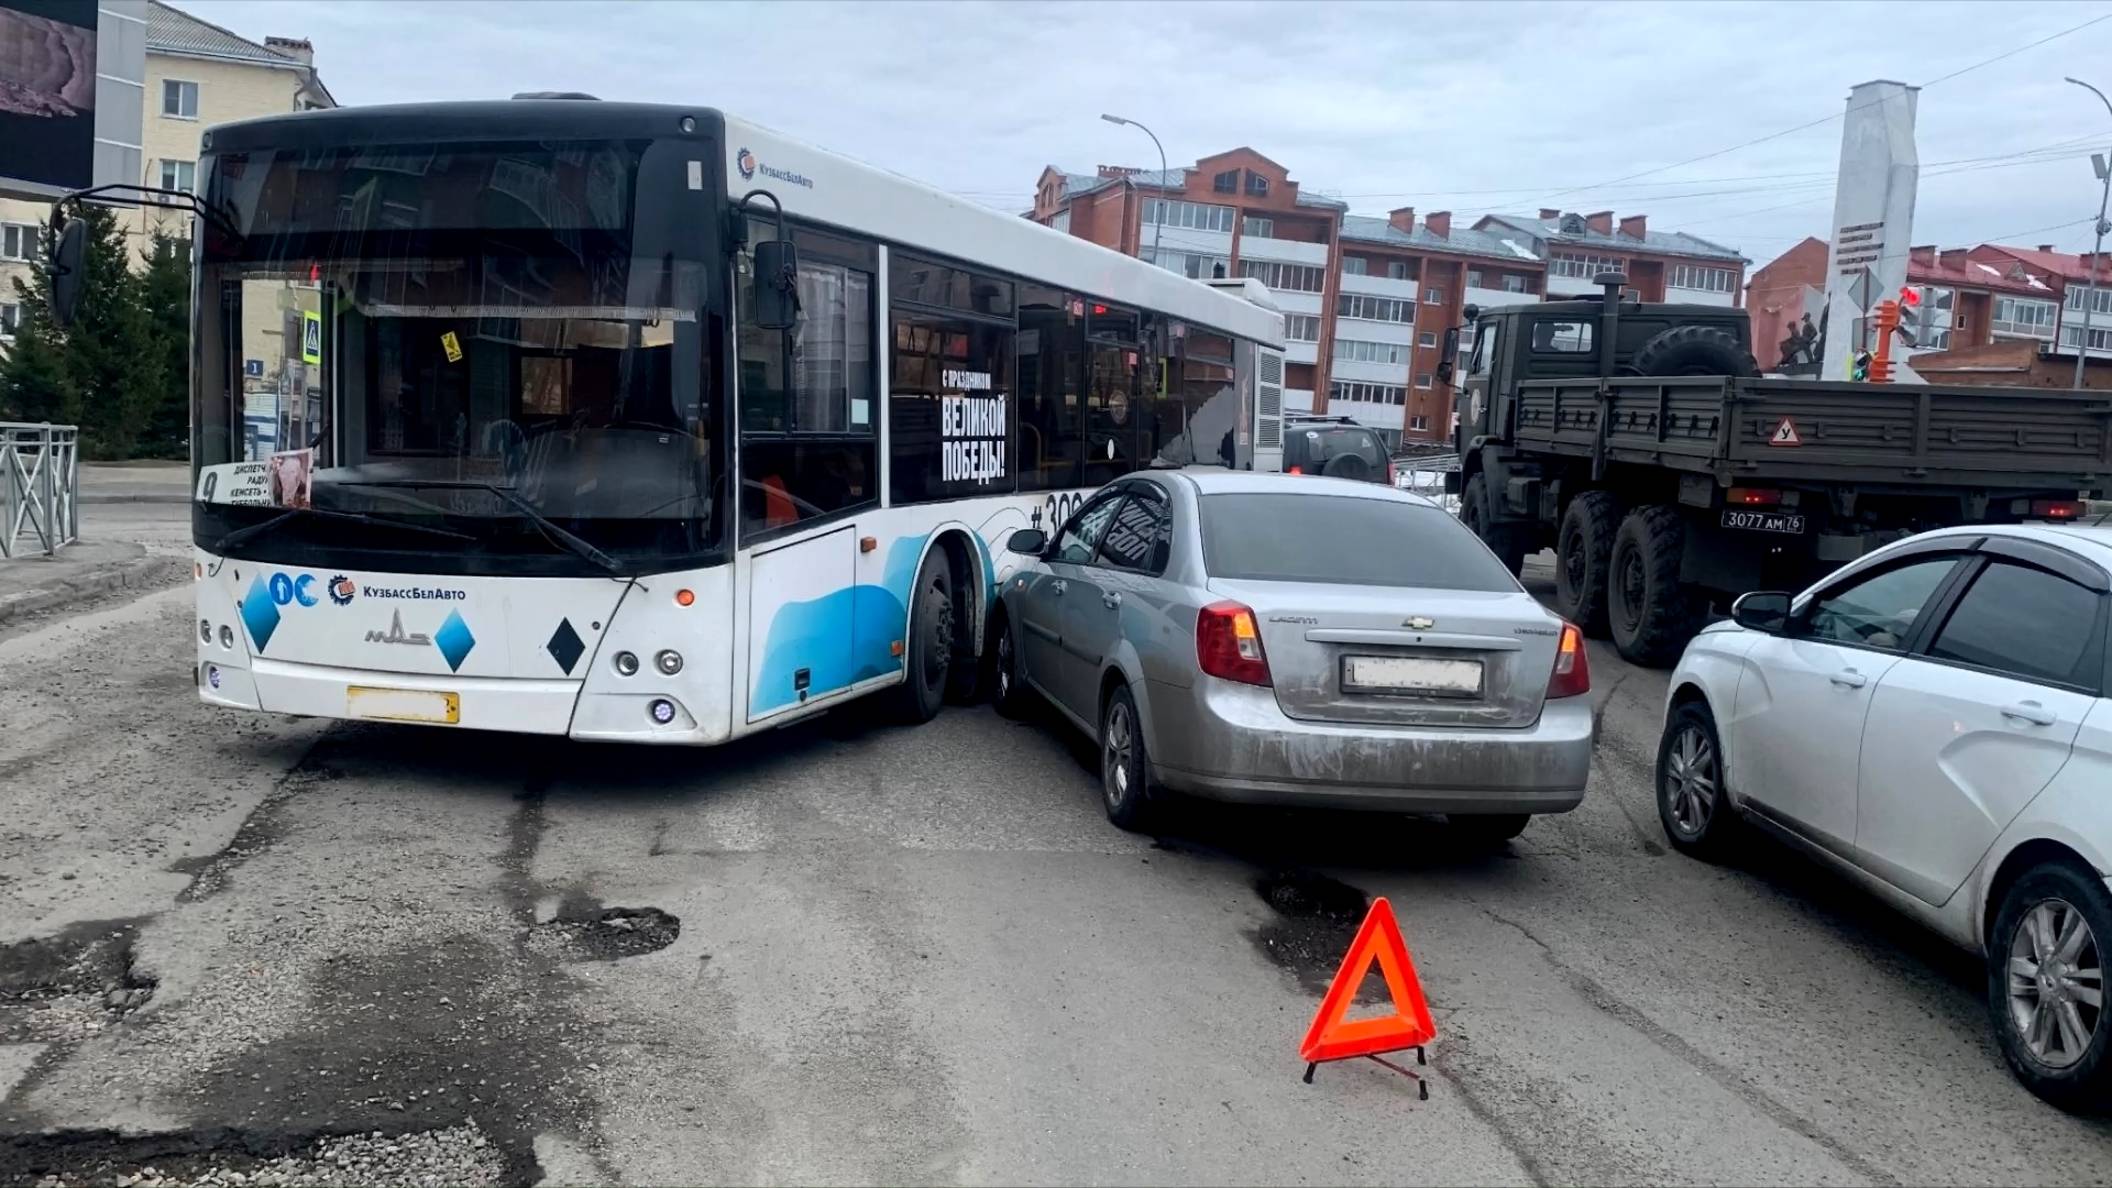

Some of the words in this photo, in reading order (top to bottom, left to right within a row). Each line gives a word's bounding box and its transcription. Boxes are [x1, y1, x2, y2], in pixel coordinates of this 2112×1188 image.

[942, 394, 1006, 437] ВЕЛИКОЙ
[1781, 428, 1791, 440] У
[942, 440, 1005, 485] ПОБЕДЫ!
[203, 471, 218, 503] 9
[1728, 512, 1764, 528] 3077
[1765, 518, 1783, 530] АМ
[1786, 516, 1800, 528] 76
